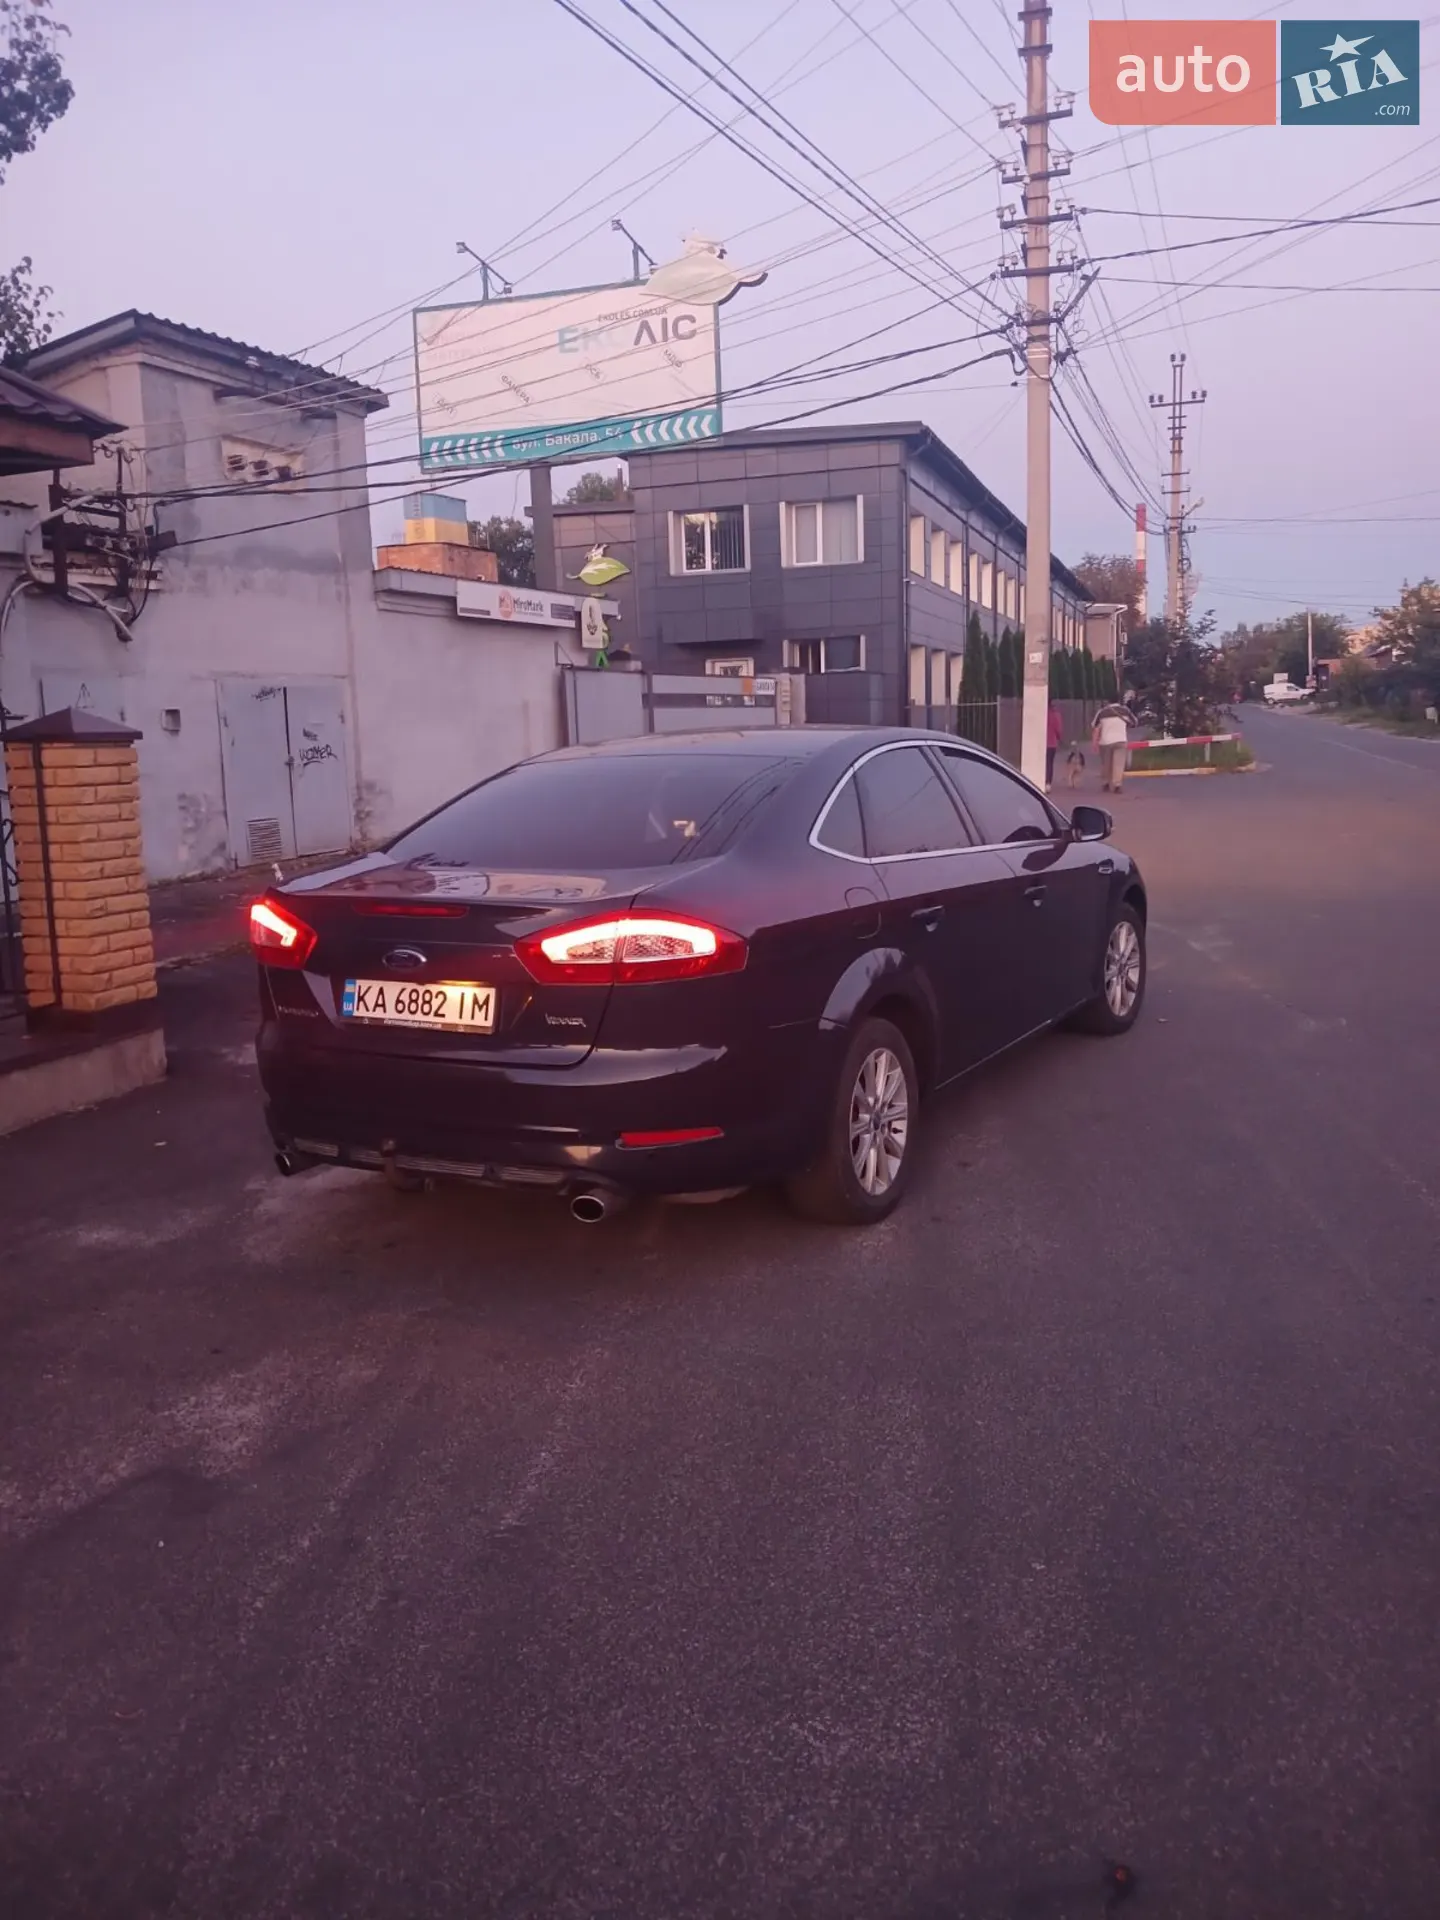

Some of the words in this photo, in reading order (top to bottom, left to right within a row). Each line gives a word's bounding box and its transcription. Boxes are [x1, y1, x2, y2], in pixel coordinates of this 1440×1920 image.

[356, 985, 387, 1013] KA
[394, 987, 448, 1018] 6882
[458, 991, 491, 1021] IM
